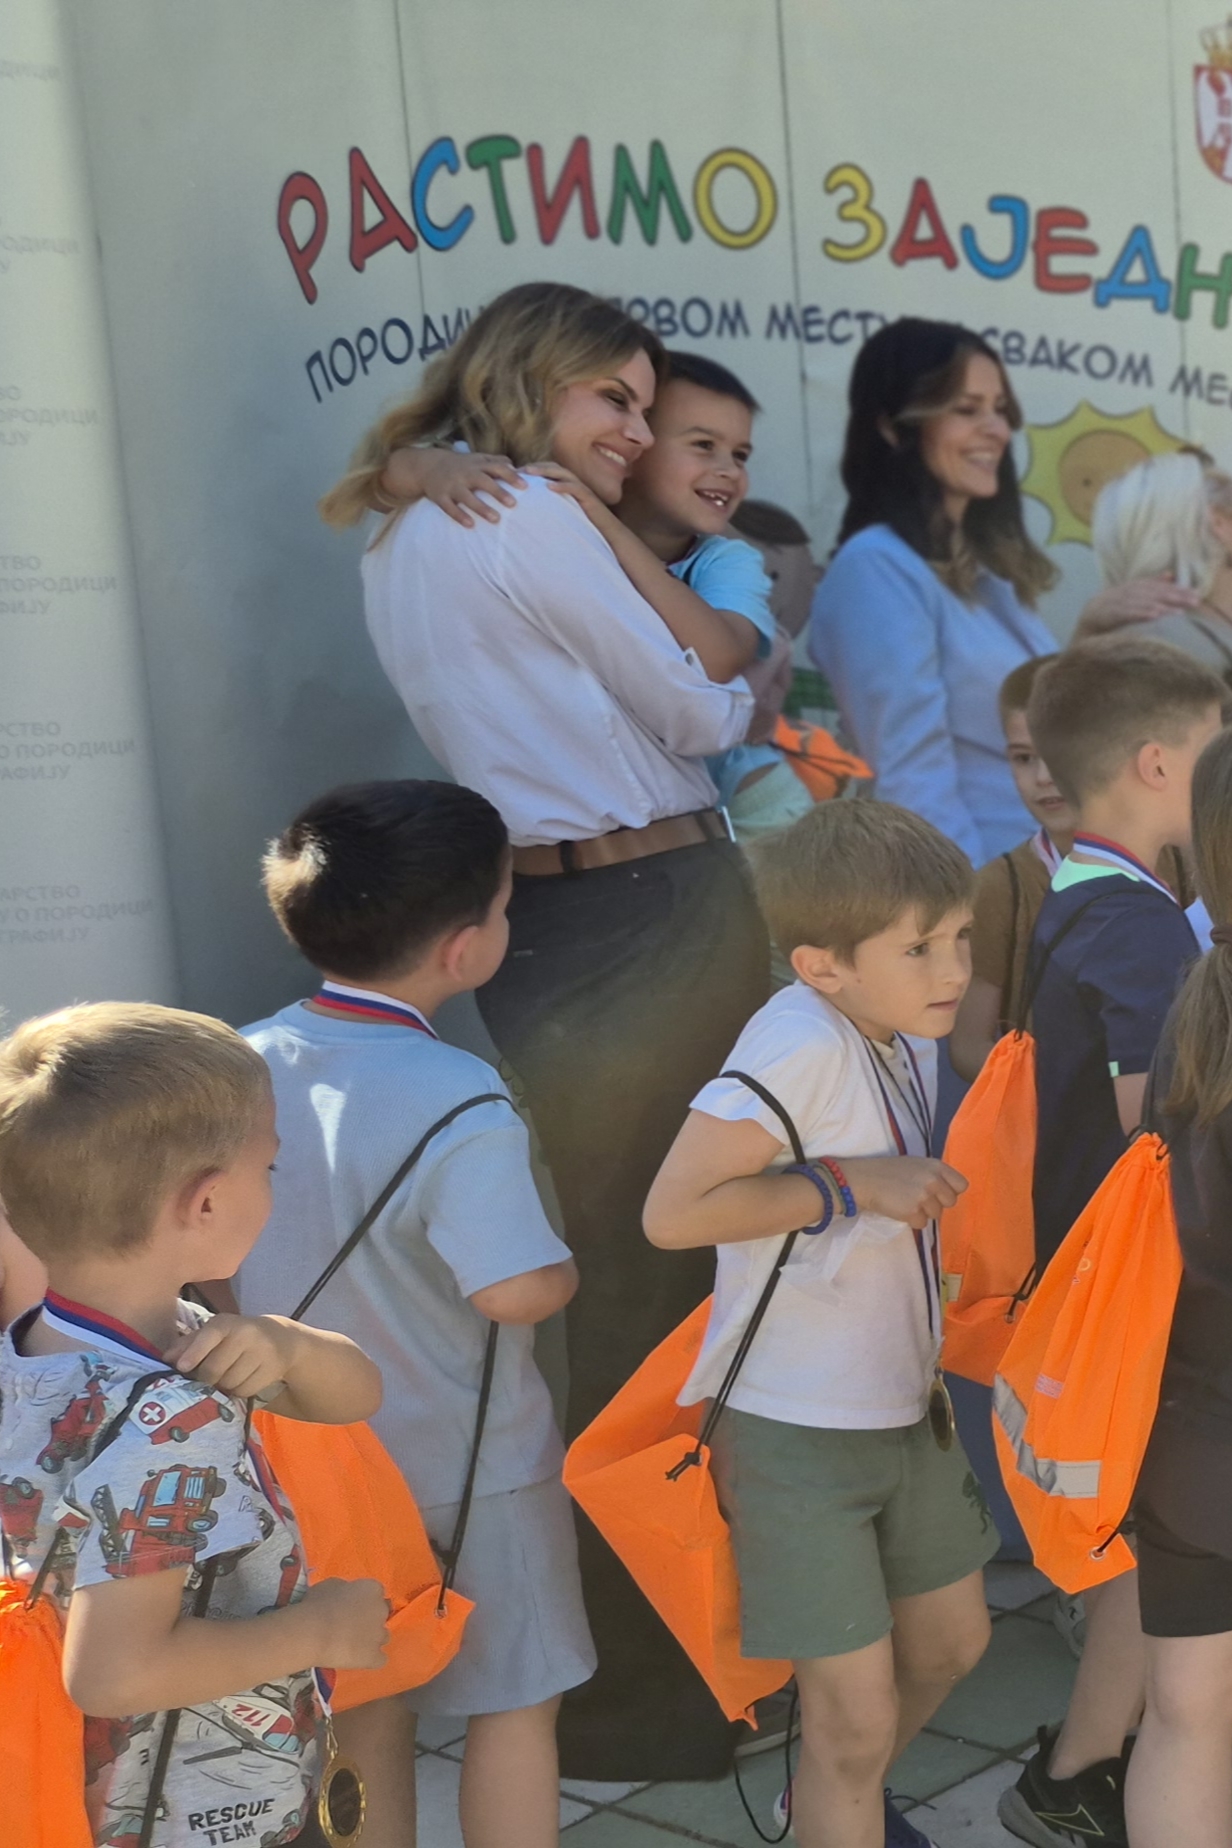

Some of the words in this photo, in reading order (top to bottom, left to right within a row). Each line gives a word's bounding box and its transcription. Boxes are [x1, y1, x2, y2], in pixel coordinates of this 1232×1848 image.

[277, 134, 778, 304] РАСТИМО
[305, 304, 488, 404] ПОРОДИ
[607, 297, 751, 340] РВОМ
[765, 303, 888, 346] МЕСТ
[188, 1798, 275, 1831] RESCUE
[203, 1820, 257, 1846] TEAM
